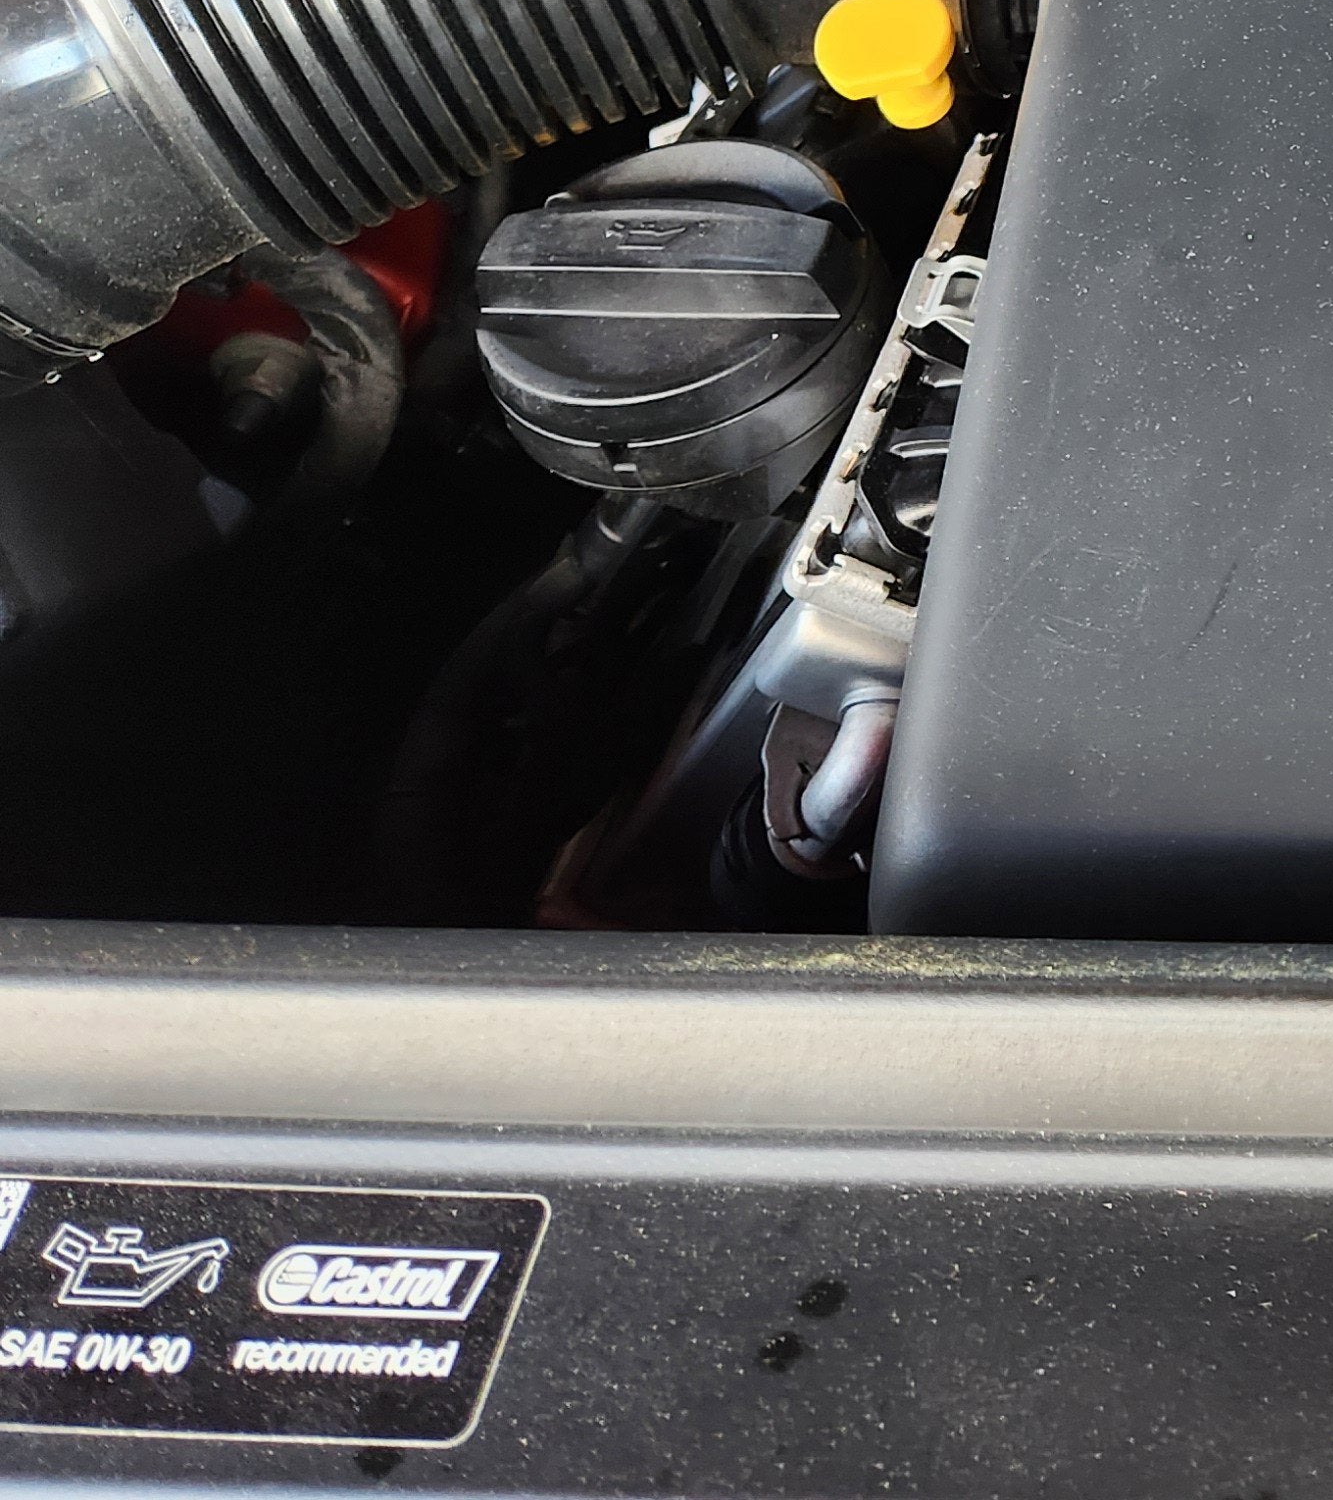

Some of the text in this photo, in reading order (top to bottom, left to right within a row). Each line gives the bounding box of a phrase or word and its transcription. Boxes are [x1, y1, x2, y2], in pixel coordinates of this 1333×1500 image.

[309, 1256, 466, 1307] Castrol
[0, 1329, 192, 1374] SAE 0W-30
[232, 1339, 460, 1378] recommended
